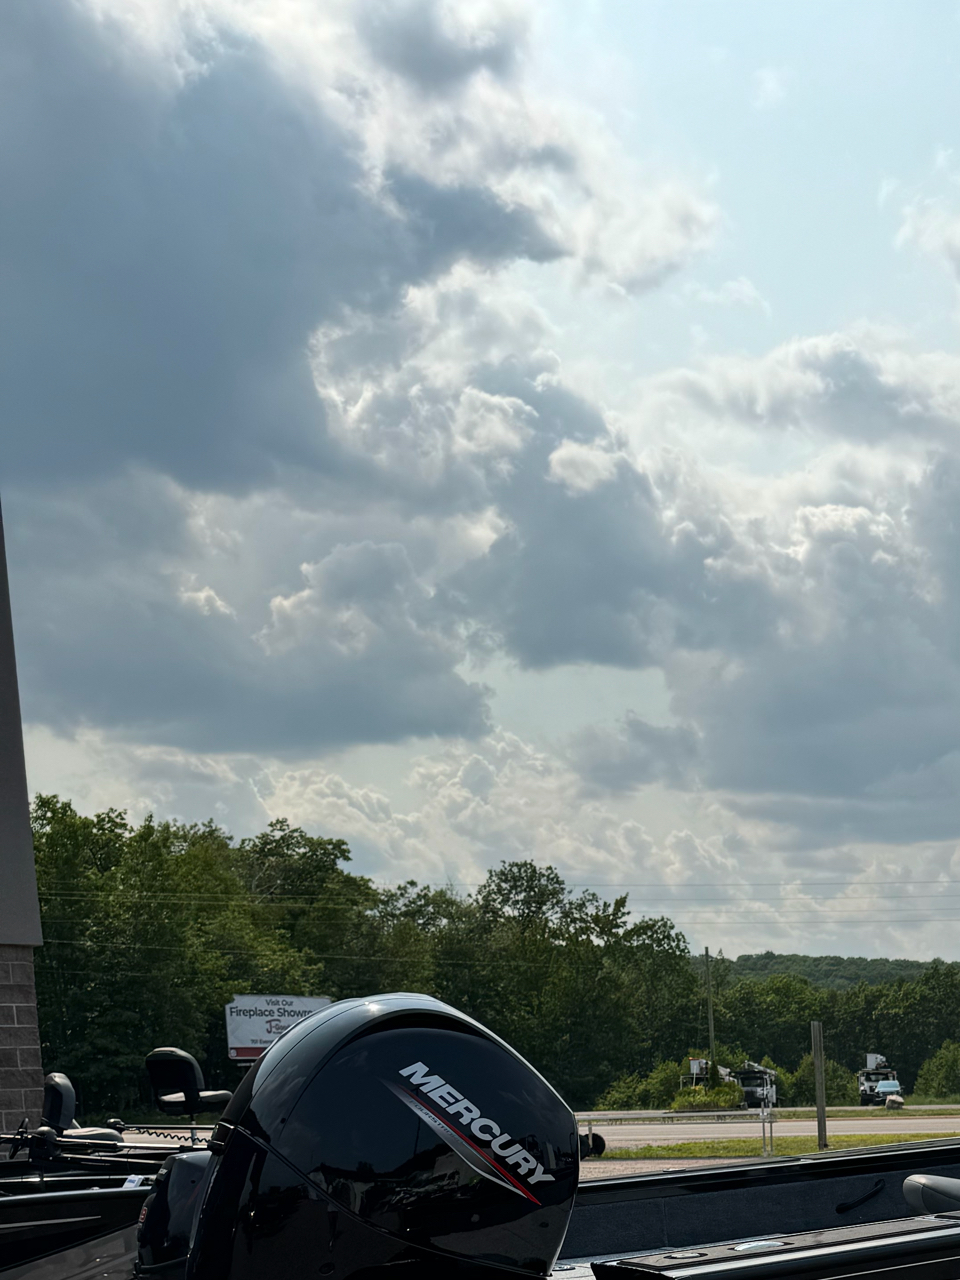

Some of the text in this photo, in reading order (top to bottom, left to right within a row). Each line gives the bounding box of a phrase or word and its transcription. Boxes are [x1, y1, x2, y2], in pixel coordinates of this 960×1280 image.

[265, 999, 294, 1007] Visit Our
[229, 1007, 275, 1019] Fireplace
[399, 1061, 556, 1185] MERCURY
